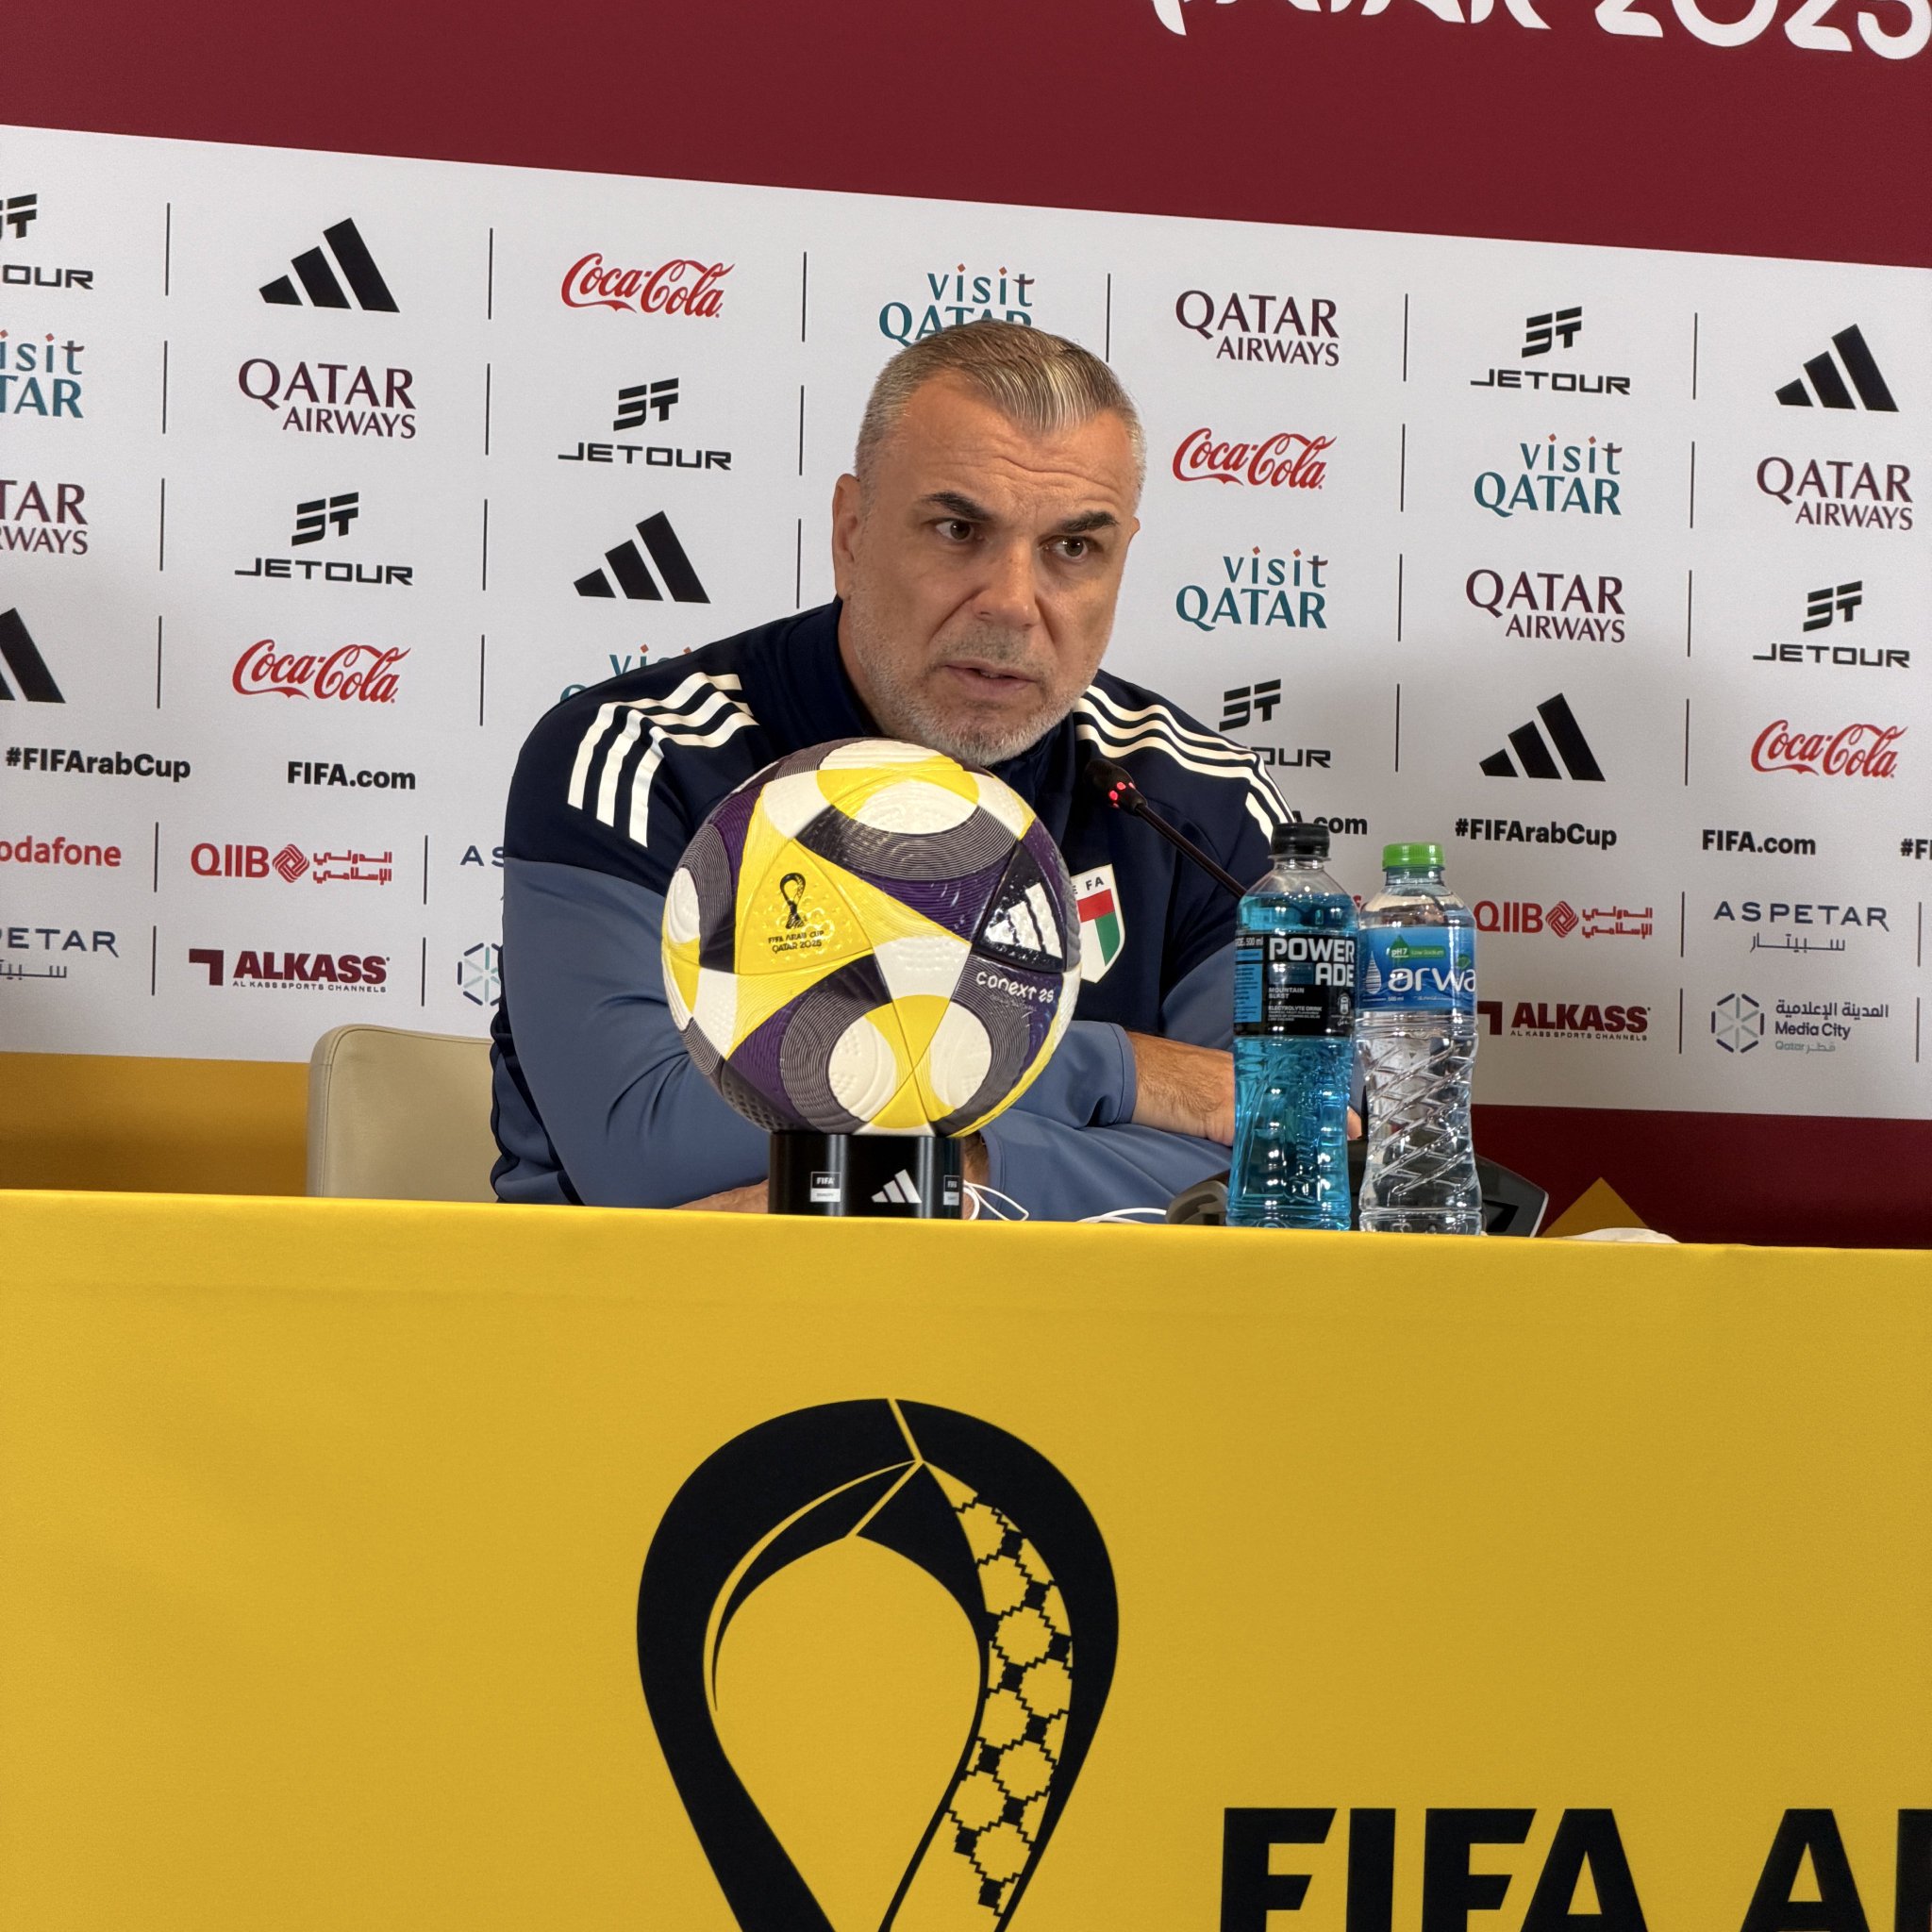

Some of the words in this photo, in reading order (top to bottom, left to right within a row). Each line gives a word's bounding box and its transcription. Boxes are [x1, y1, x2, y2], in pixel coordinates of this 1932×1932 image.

[561, 253, 734, 317] Coca-Cola
[927, 263, 1035, 308] visit
[1175, 290, 1340, 339] QATAR
[1216, 336, 1340, 367] AIRWAYS
[238, 358, 416, 410] QATAR
[1470, 368, 1630, 395] JETOUR
[282, 407, 416, 440] AIRWAYS
[558, 441, 732, 471] JETOUR
[1173, 427, 1337, 490] Coca-Cola
[1520, 433, 1623, 475] visit
[1474, 472, 1622, 517] QATAR
[1757, 457, 1913, 505] QATAR
[1794, 502, 1913, 531] AIRWAYS
[234, 558, 413, 586] JETOUR
[1223, 545, 1328, 589] visit
[1175, 585, 1327, 632] QATAR
[1465, 569, 1625, 619] QATAR
[1505, 613, 1625, 643] AIRWAYS
[232, 639, 411, 704] Coca-Cola
[1752, 643, 1910, 669] JETOUR
[1751, 719, 1907, 778] Coca-Cola
[6, 746, 192, 783] #FIFArabCup
[287, 760, 416, 791] FIFA.com
[1455, 818, 1617, 851] #FIFArabCup
[1702, 828, 1816, 856] FIFA.com
[191, 842, 270, 878] QIIB
[1085, 876, 1105, 891] FA
[1474, 900, 1543, 934] QIIB
[1713, 901, 1890, 932] ASPETAR
[772, 942, 798, 954] QATAR
[800, 940, 822, 948] 2025
[786, 932, 807, 941] ARAB
[1269, 938, 1356, 963] POWER
[232, 950, 387, 985] ALKASS
[1315, 962, 1356, 987] ADE
[281, 982, 325, 991] SPORTS
[327, 984, 387, 993] CHANNELS
[1511, 1002, 1648, 1033] ALKASS
[1841, 1002, 1889, 1020] المدينة
[1554, 1031, 1592, 1040] SPORTS
[1595, 1033, 1648, 1041] CHANNELS
[1774, 1022, 1820, 1037] Media
[1822, 1023, 1851, 1040] City
[1774, 1041, 1805, 1051] Qatar
[1220, 1807, 1649, 1932] FIFA
